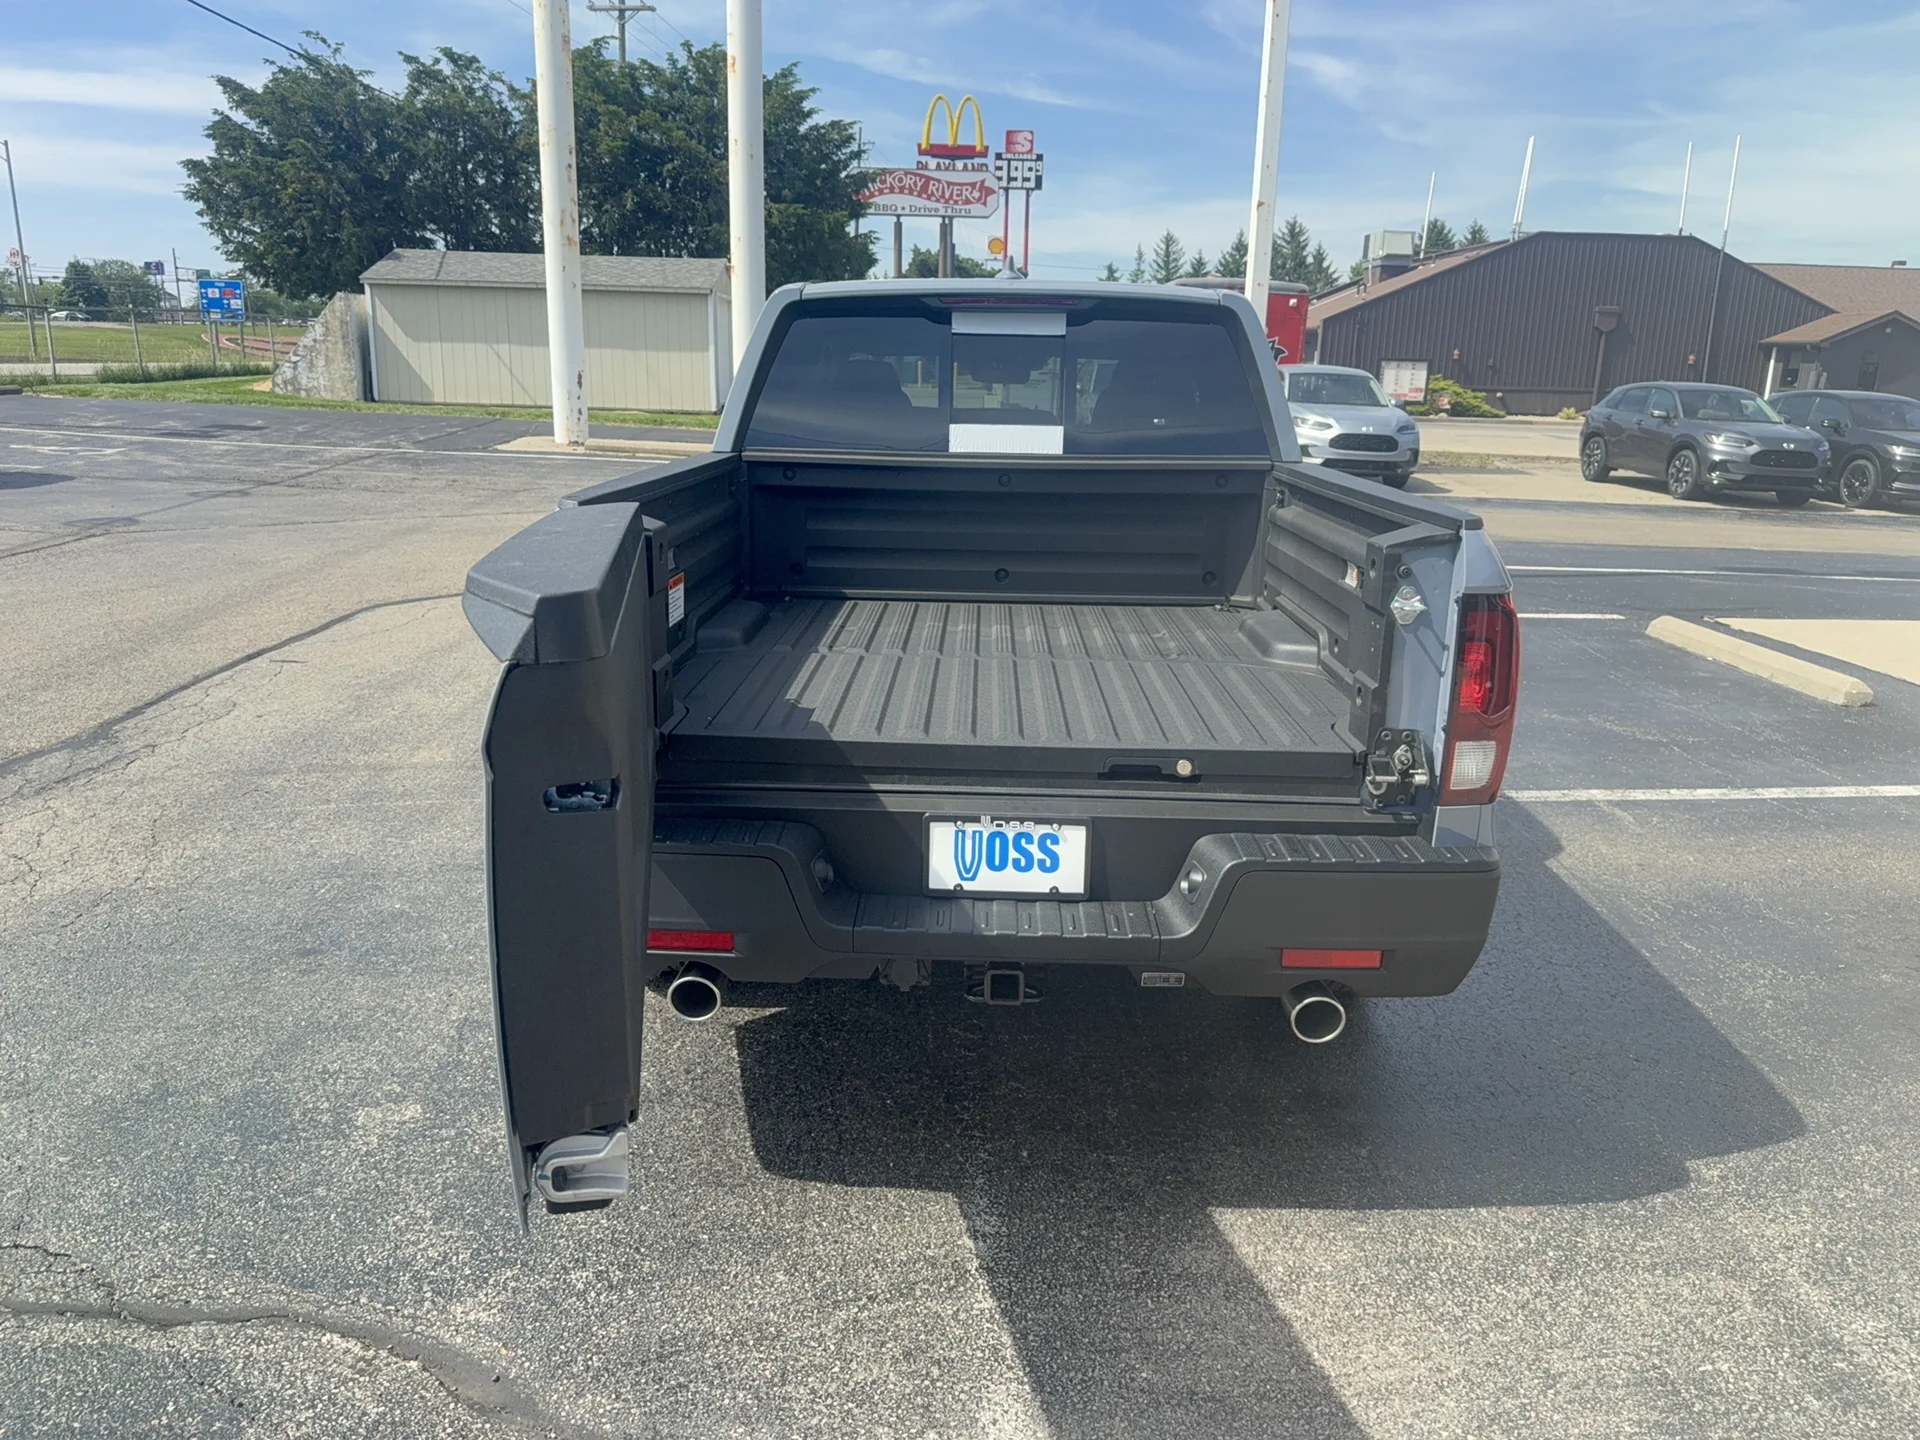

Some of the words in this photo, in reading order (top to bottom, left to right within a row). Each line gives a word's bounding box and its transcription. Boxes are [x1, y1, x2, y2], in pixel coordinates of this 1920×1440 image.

[927, 180, 977, 202] RIVER
[874, 203, 898, 213] BBQ
[908, 204, 940, 214] Drive
[942, 205, 972, 215] Thru
[953, 828, 1061, 882] VOSS
